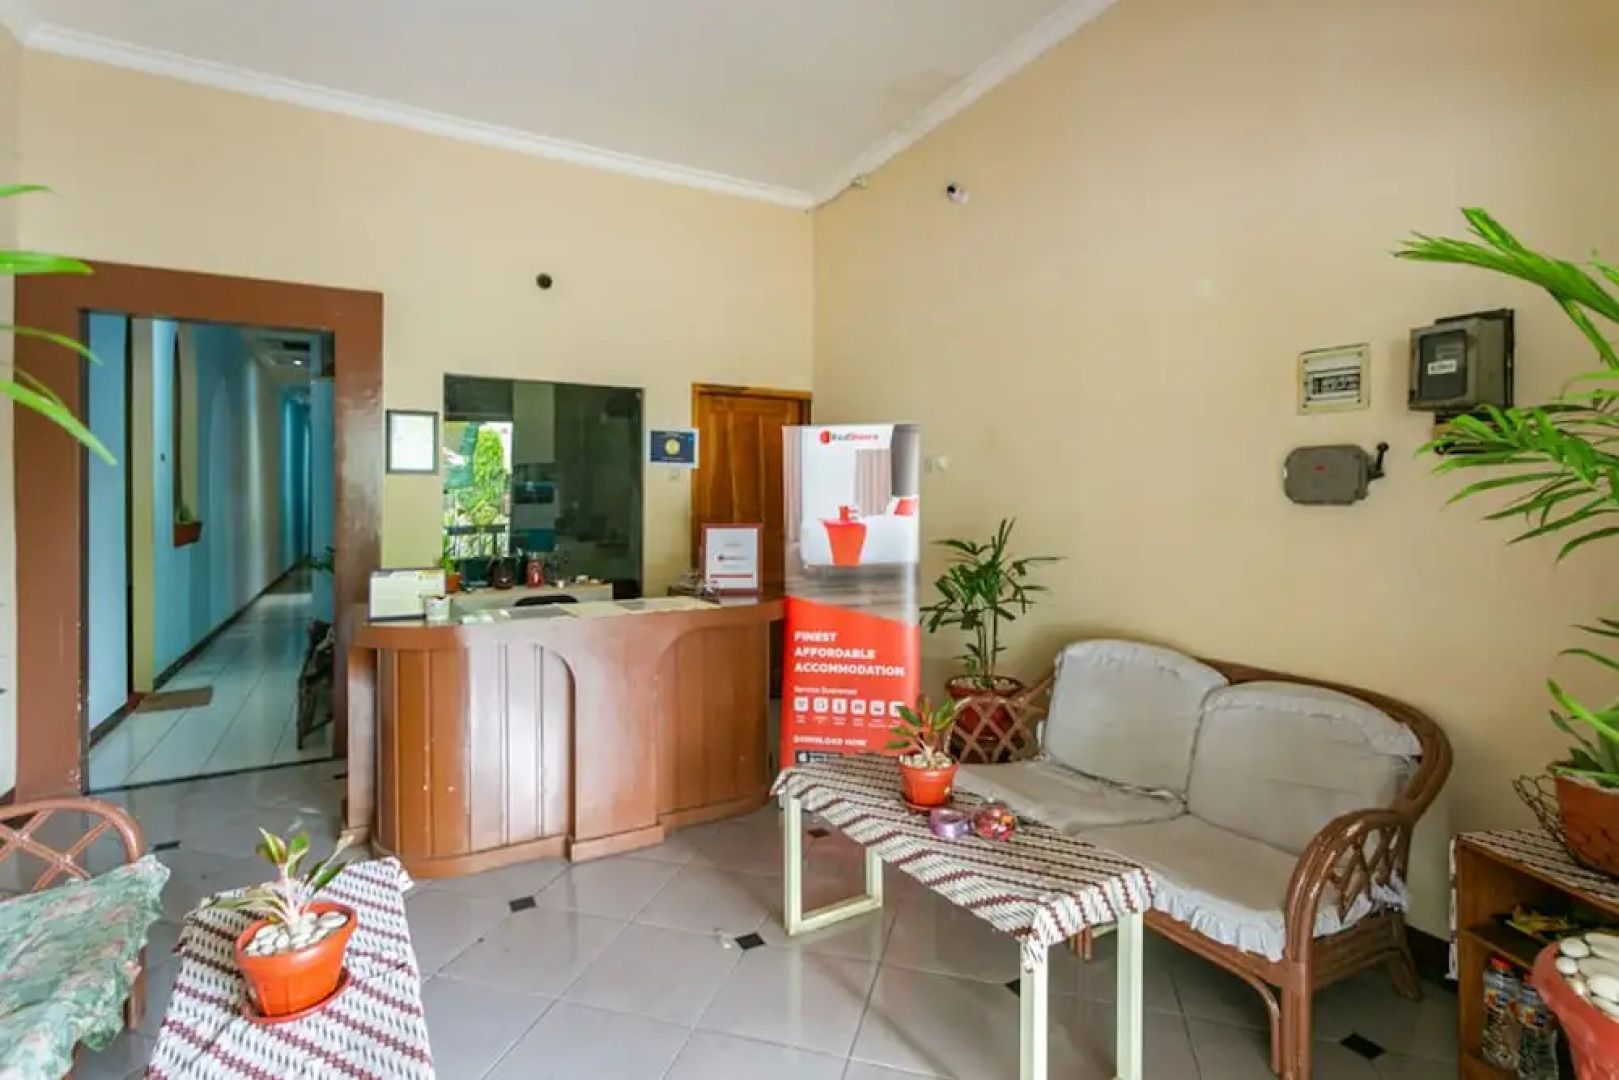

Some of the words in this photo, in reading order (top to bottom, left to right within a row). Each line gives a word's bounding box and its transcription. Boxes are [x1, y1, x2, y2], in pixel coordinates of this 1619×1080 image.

[794, 631, 836, 642] FINEST
[794, 647, 876, 660] AFFORDABLE
[794, 662, 905, 676] ACCOMMODATION
[794, 735, 843, 745] DOWNLOAD
[845, 738, 867, 747] NOW
